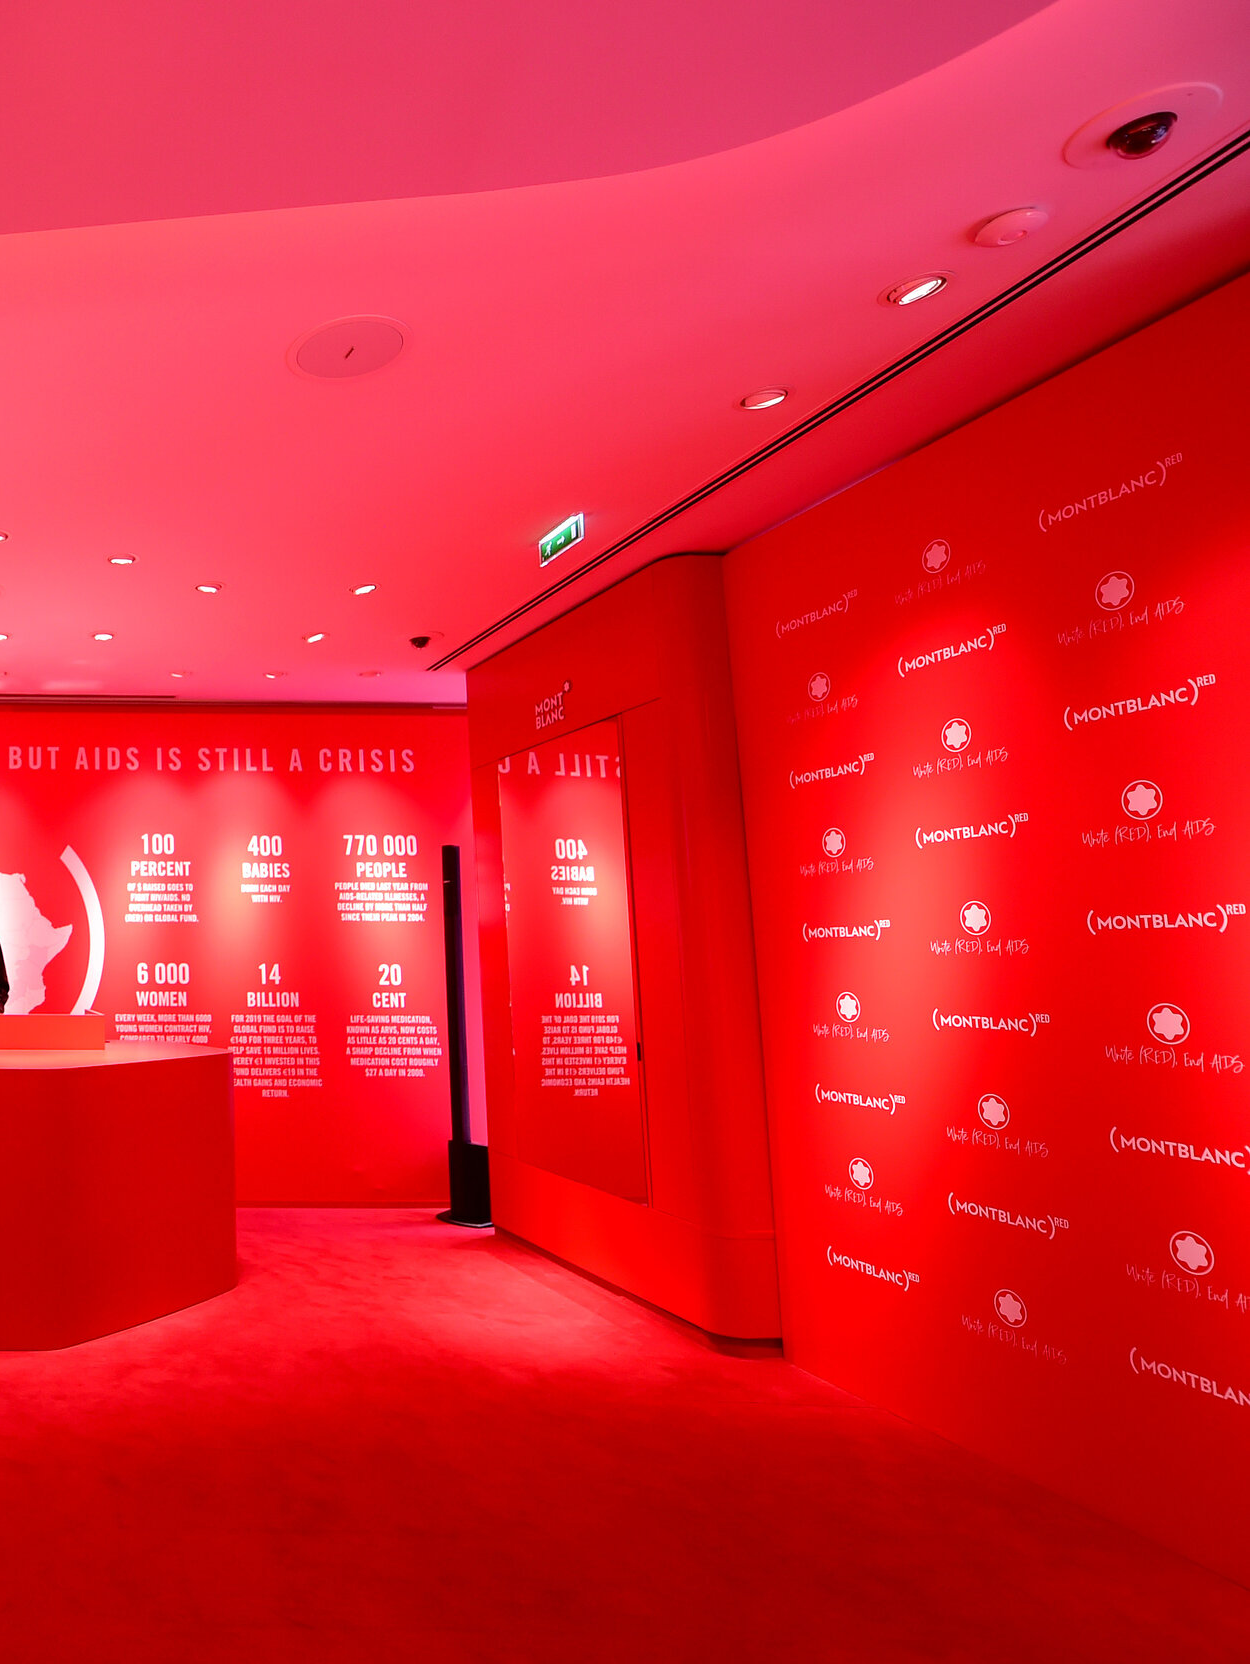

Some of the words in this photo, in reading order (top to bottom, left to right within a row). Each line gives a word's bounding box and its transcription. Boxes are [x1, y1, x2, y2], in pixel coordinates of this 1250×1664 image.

[535, 692, 564, 717] MONT
[535, 707, 564, 729] BLANC
[9, 746, 59, 770] BUT
[75, 747, 139, 771] AIDS
[157, 747, 181, 771] IS
[198, 748, 273, 771] STILL
[289, 748, 302, 772] A
[319, 748, 414, 772] CRISIS
[967, 752, 981, 768] End
[986, 747, 1008, 764] AIDS
[1158, 822, 1176, 841] End
[1182, 818, 1216, 837] AIDS
[141, 833, 174, 854] 100
[247, 835, 282, 856] 400
[343, 835, 377, 856] 770
[383, 835, 417, 856] 000
[131, 861, 191, 876] PERCENT
[242, 862, 290, 878] BABIES
[356, 862, 407, 878] PEOPLE
[987, 939, 1001, 954] End
[1006, 939, 1029, 955] AIDS
[137, 962, 148, 984] 6
[155, 963, 189, 984] 000
[258, 963, 281, 984] 14
[378, 964, 402, 986] 20
[136, 991, 187, 1006] WOMEN
[247, 992, 299, 1007] BILLION
[373, 992, 406, 1008] CENT
[230, 1014, 245, 1023] FOR
[245, 1014, 262, 1023] 2019
[263, 1014, 275, 1023] THE
[276, 1014, 293, 1023] GOAL
[294, 1014, 302, 1023] OF
[304, 1014, 317, 1023] THE
[350, 1014, 390, 1024] LIFE-SAVING
[391, 1014, 433, 1024] MEDICATION,
[233, 1025, 258, 1034] GLOBAL
[259, 1025, 277, 1034] FUND
[278, 1025, 285, 1034] IS
[286, 1025, 295, 1034] TO
[295, 1025, 315, 1034] RAISE
[346, 1025, 370, 1035] KNOWN
[371, 1025, 380, 1035] AS
[416, 1025, 438, 1035] COSTS
[248, 1035, 262, 1044] FOR
[263, 1035, 284, 1044] THREE
[284, 1035, 308, 1044] YEARS,
[308, 1035, 317, 1044] TO
[346, 1036, 356, 1046] AS
[378, 1036, 387, 1046] AS
[387, 1036, 397, 1046] 20
[397, 1036, 418, 1046] CENTS
[419, 1036, 424, 1046] A
[245, 1046, 262, 1055] SAVE
[272, 1046, 299, 1055] MILLION
[345, 1046, 351, 1056] A
[351, 1046, 373, 1056] SHARP
[374, 1046, 402, 1056] DECLINE
[403, 1046, 422, 1056] FROM
[422, 1046, 443, 1056] WHEN
[264, 1057, 296, 1066] INVESTED
[296, 1057, 304, 1066] IN
[305, 1057, 321, 1066] THIS
[350, 1057, 390, 1066] MEDICATION
[391, 1057, 408, 1066] COST
[408, 1057, 439, 1066] ROUGHLY
[1184, 1052, 1204, 1072] End
[1210, 1054, 1245, 1073] AIDS
[250, 1067, 282, 1077] DELIVERS
[296, 1067, 305, 1077] IN
[305, 1067, 318, 1077] THE
[365, 1068, 377, 1077] $27
[378, 1068, 384, 1077] A
[384, 1068, 398, 1077] DAY
[398, 1068, 406, 1077] IN
[253, 1078, 273, 1087] GAINS
[273, 1078, 288, 1087] AND
[288, 1078, 323, 1087] ECONOMIC
[1005, 1138, 1020, 1154] End
[1025, 1140, 1048, 1157] AIDS
